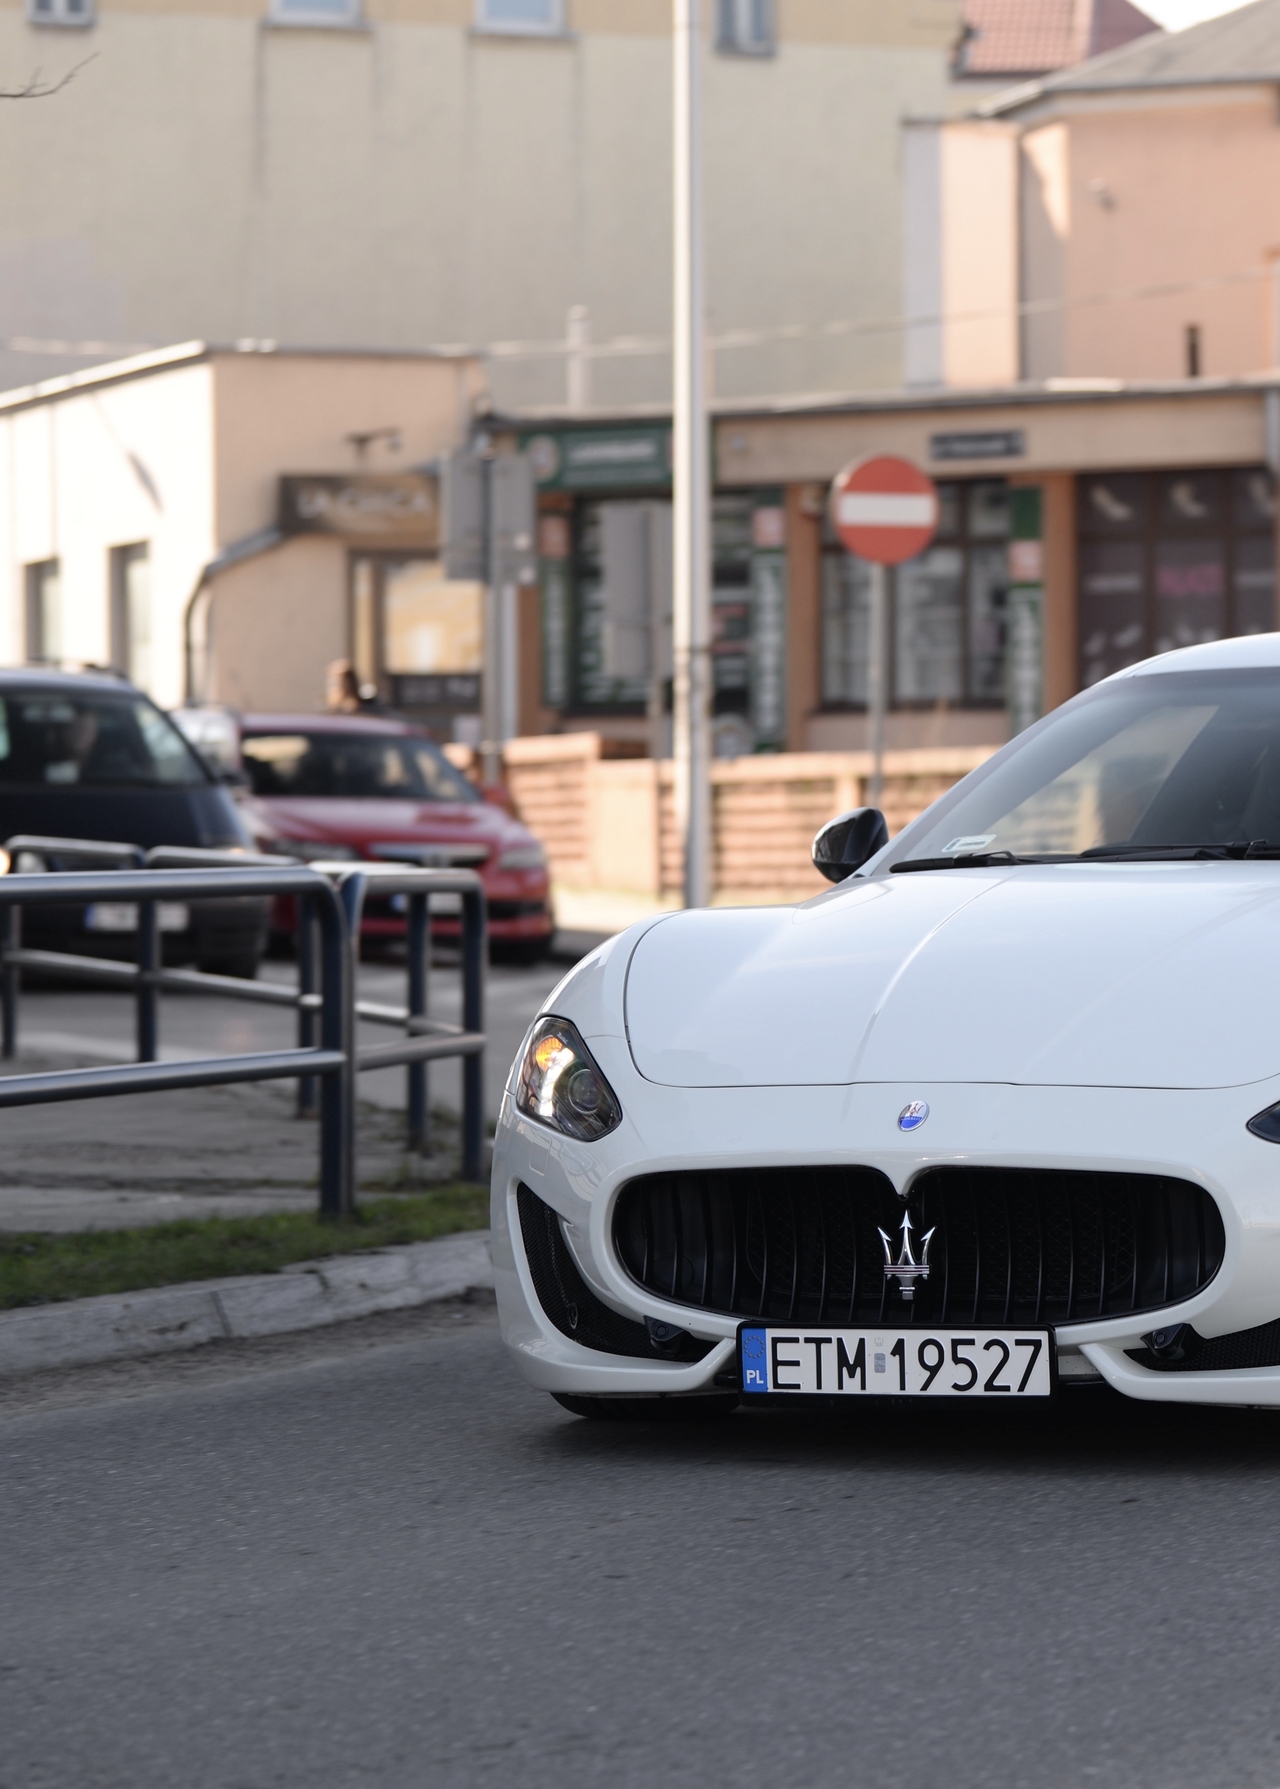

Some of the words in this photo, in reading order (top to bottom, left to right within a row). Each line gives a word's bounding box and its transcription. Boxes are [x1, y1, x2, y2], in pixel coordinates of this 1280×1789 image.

[746, 1369, 764, 1385] PL
[770, 1336, 867, 1391] ETM
[889, 1337, 1043, 1392] 19527
